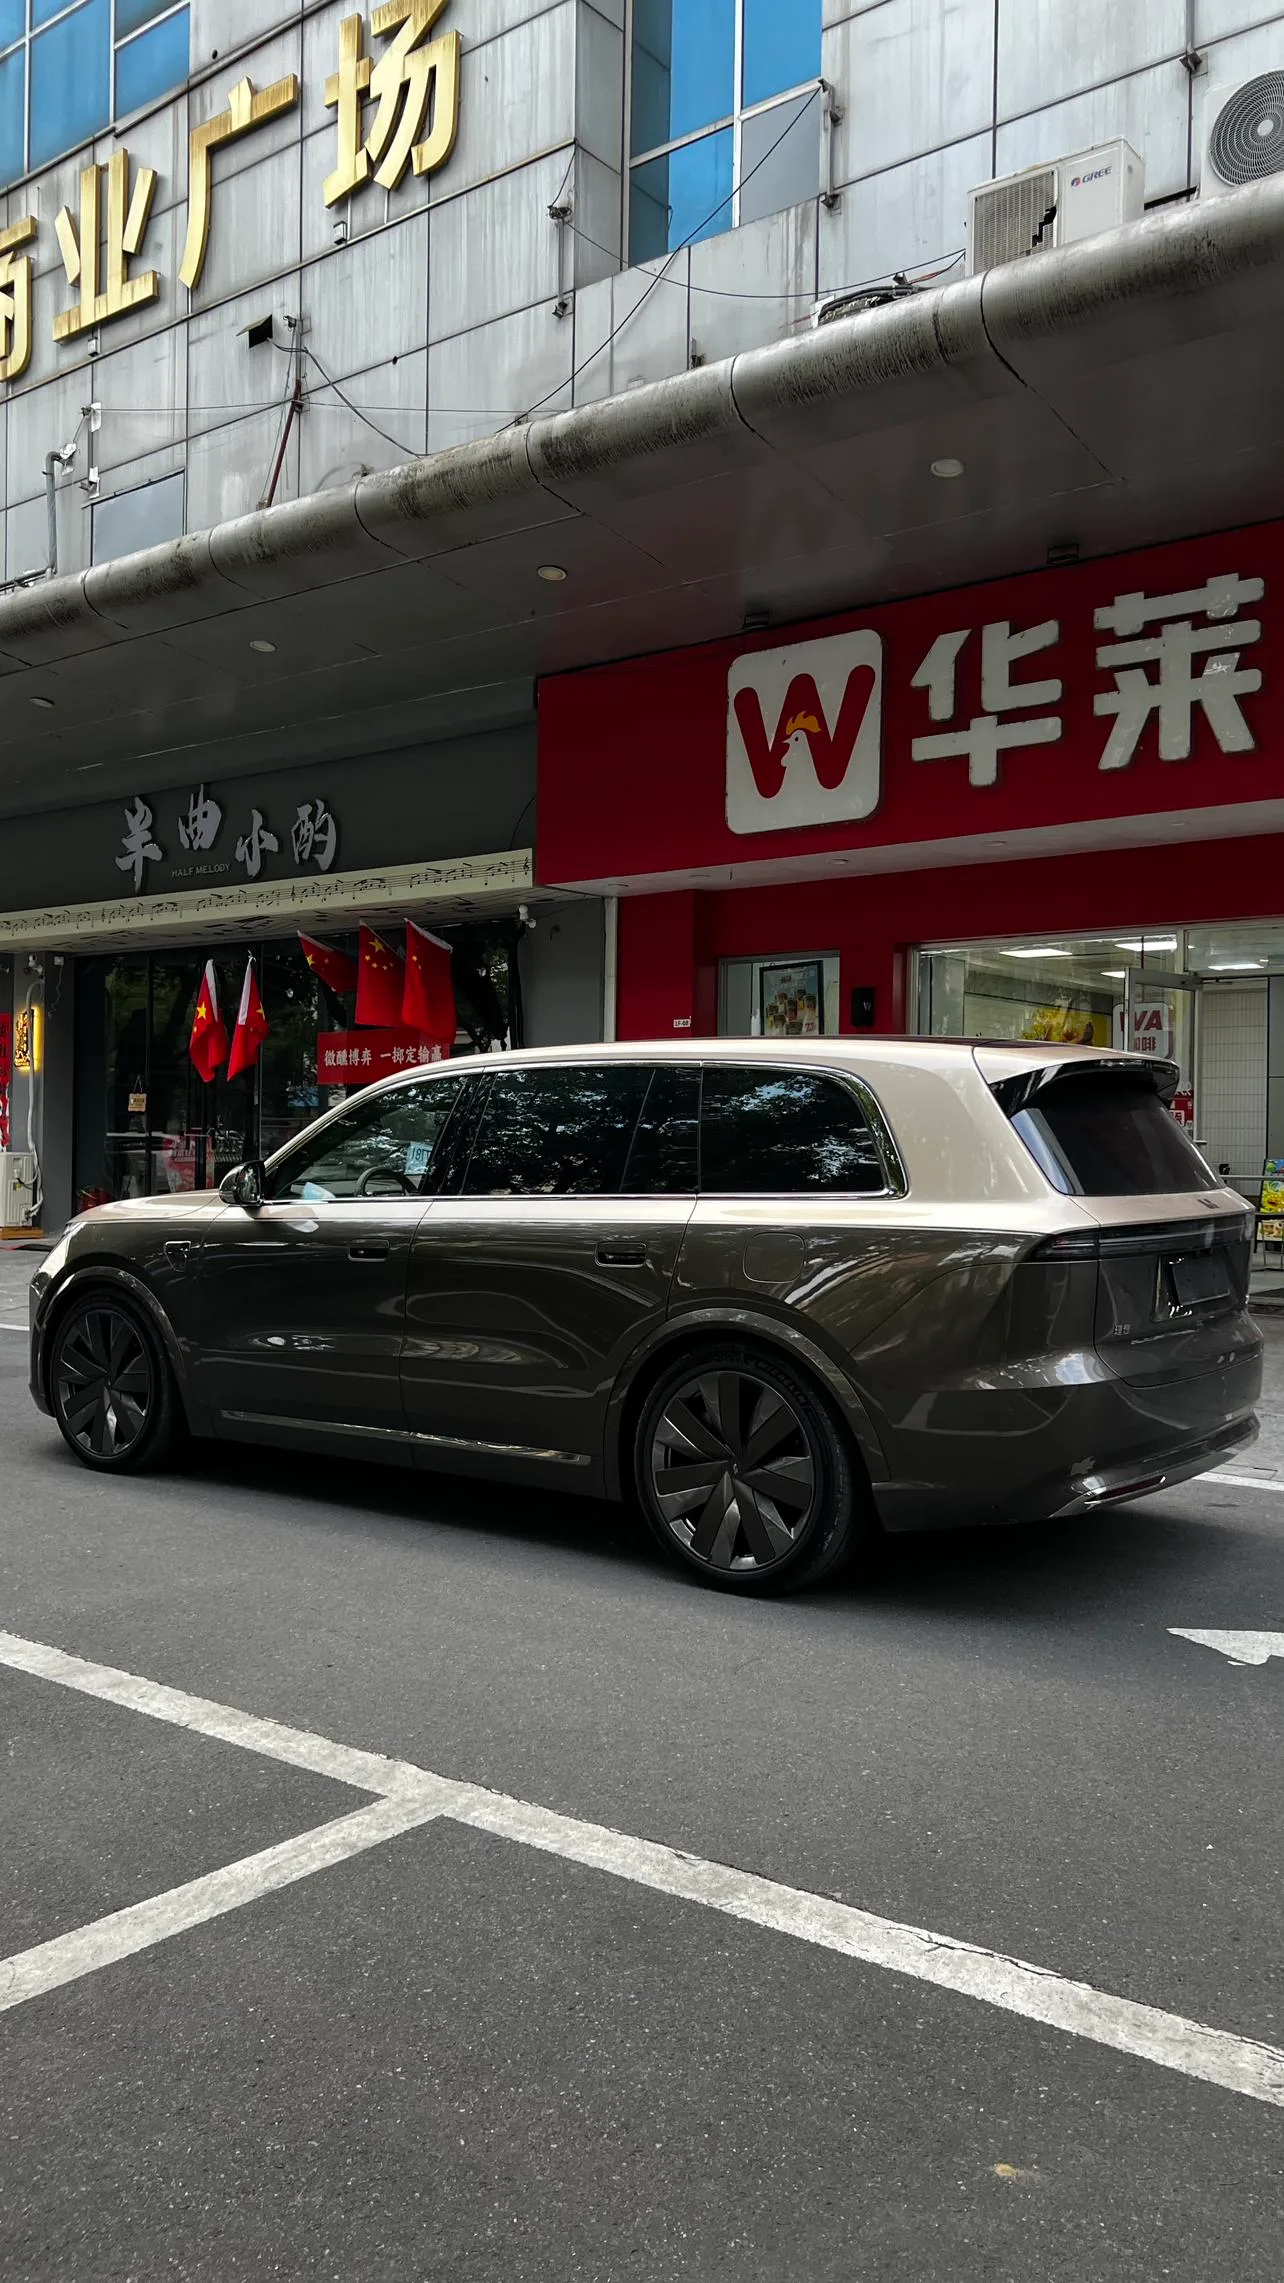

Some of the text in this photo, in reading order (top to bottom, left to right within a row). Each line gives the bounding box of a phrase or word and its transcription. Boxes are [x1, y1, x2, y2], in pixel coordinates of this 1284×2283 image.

[1082, 166, 1112, 183] GREE
[910, 573, 1265, 787] 华莱
[172, 863, 230, 878] HALF MELODY
